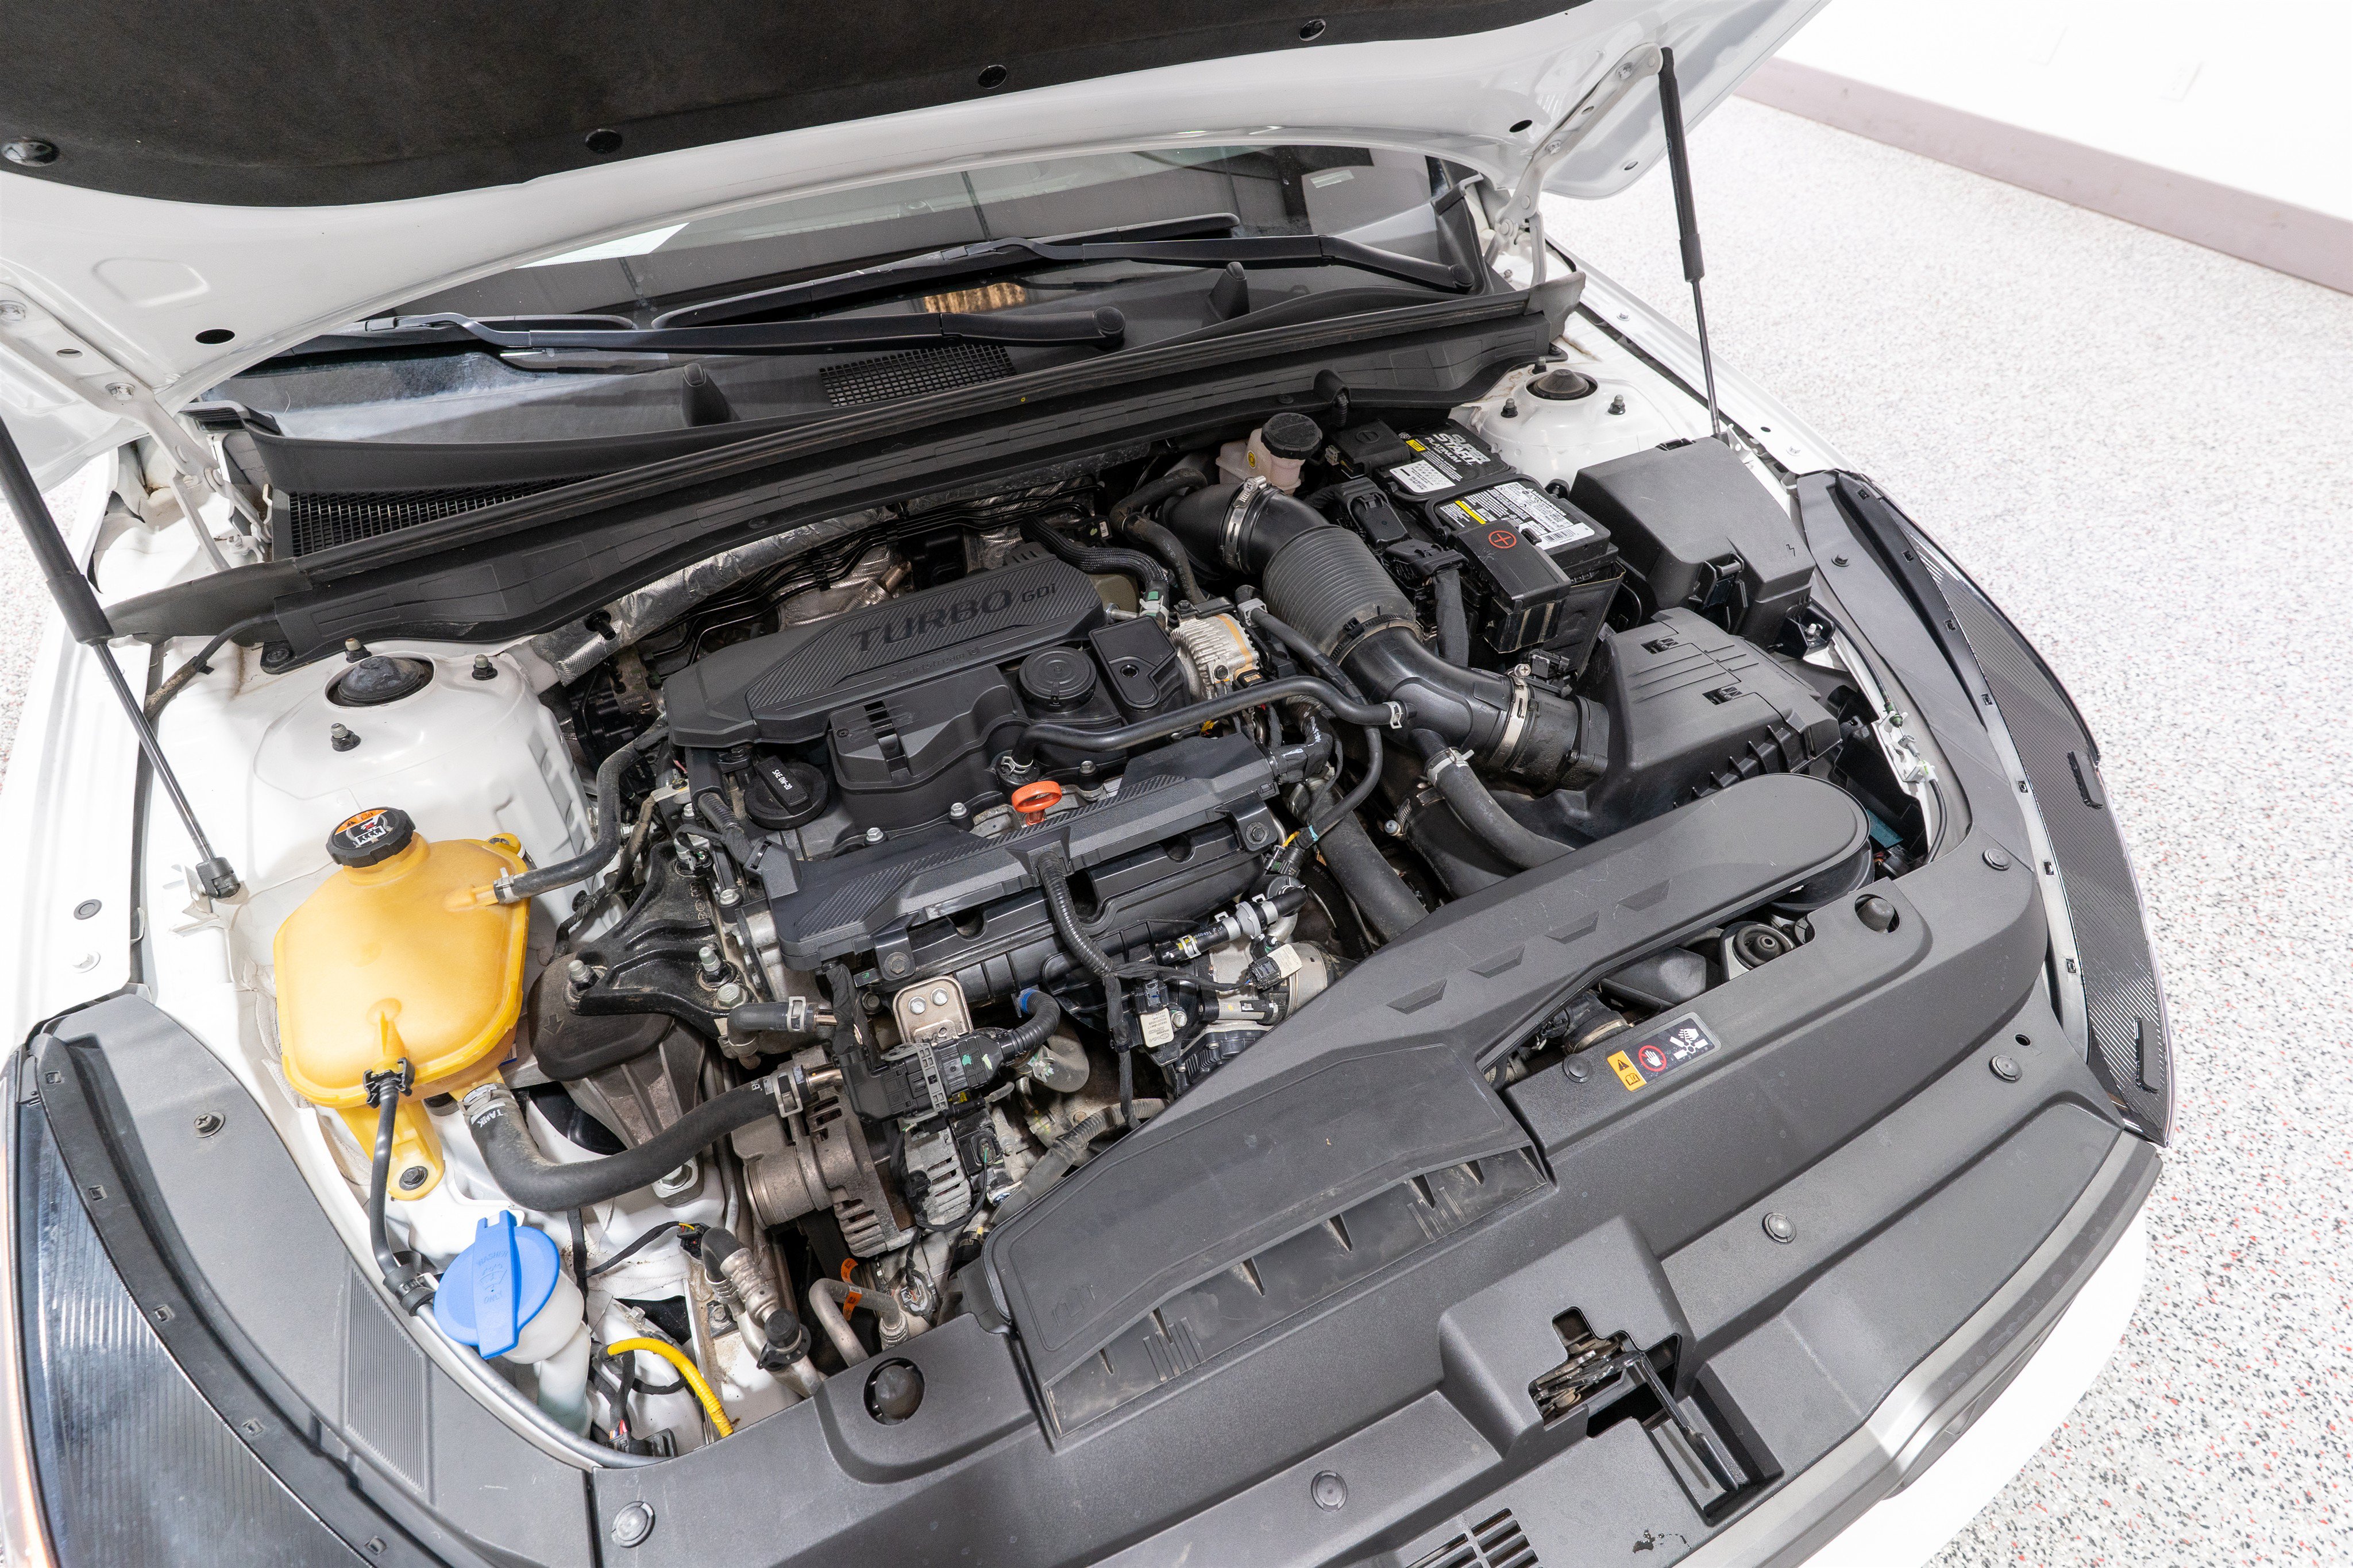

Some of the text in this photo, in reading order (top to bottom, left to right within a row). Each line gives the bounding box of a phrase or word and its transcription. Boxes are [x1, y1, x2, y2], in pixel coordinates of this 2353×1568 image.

[1425, 437, 1463, 464] PLATINUM
[1433, 433, 1483, 465] START
[1451, 434, 1491, 463] SUPER
[1533, 491, 1567, 516] DANGER/POISON
[849, 583, 1057, 654] TURBO GDi
[892, 652, 966, 680] Smartstream
[772, 769, 793, 790] SAE 0W-20
[477, 1110, 504, 1129] TANK
[477, 1251, 509, 1266] WASHER
[484, 1290, 503, 1304] ONLY
